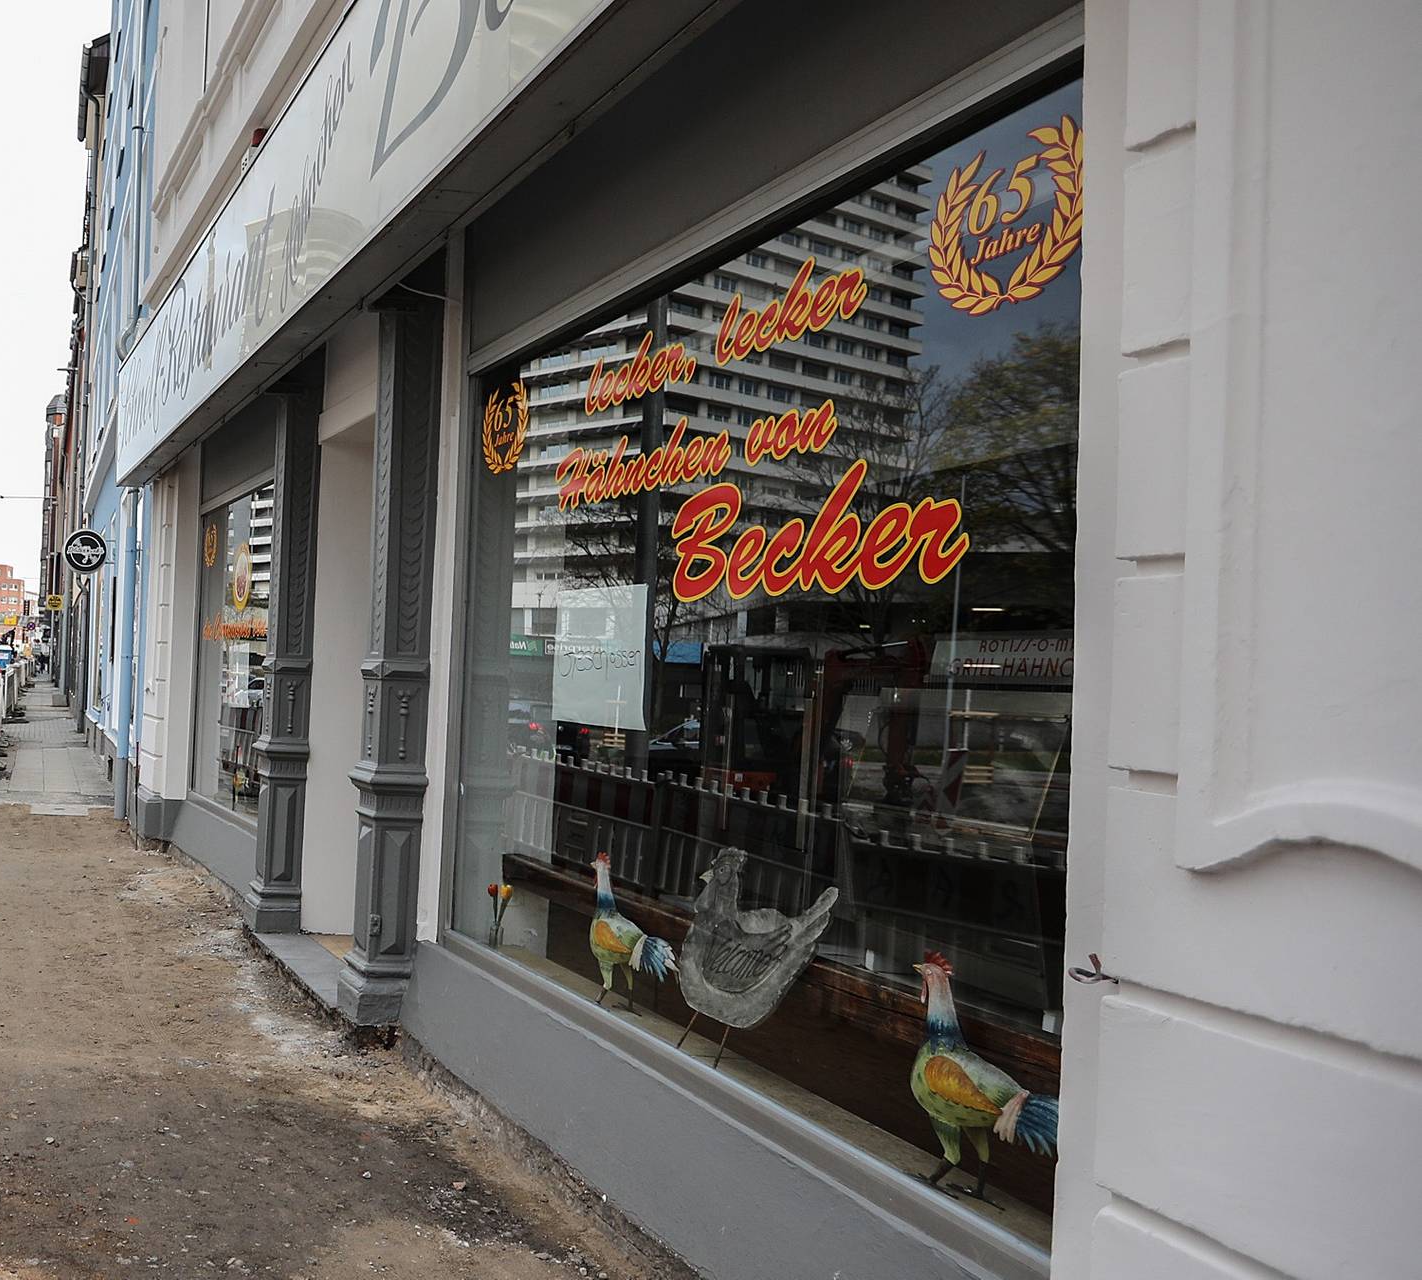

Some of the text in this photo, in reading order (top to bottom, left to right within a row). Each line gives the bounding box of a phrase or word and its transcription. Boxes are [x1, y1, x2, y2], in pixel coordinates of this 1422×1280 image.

[967, 154, 1040, 236] 65
[970, 222, 1043, 265] Jahre
[584, 255, 867, 417] lecker, lecker
[493, 394, 515, 432] 65
[494, 432, 516, 448] Jahre
[555, 399, 838, 513] Hähnchen von
[672, 458, 970, 602] Becker
